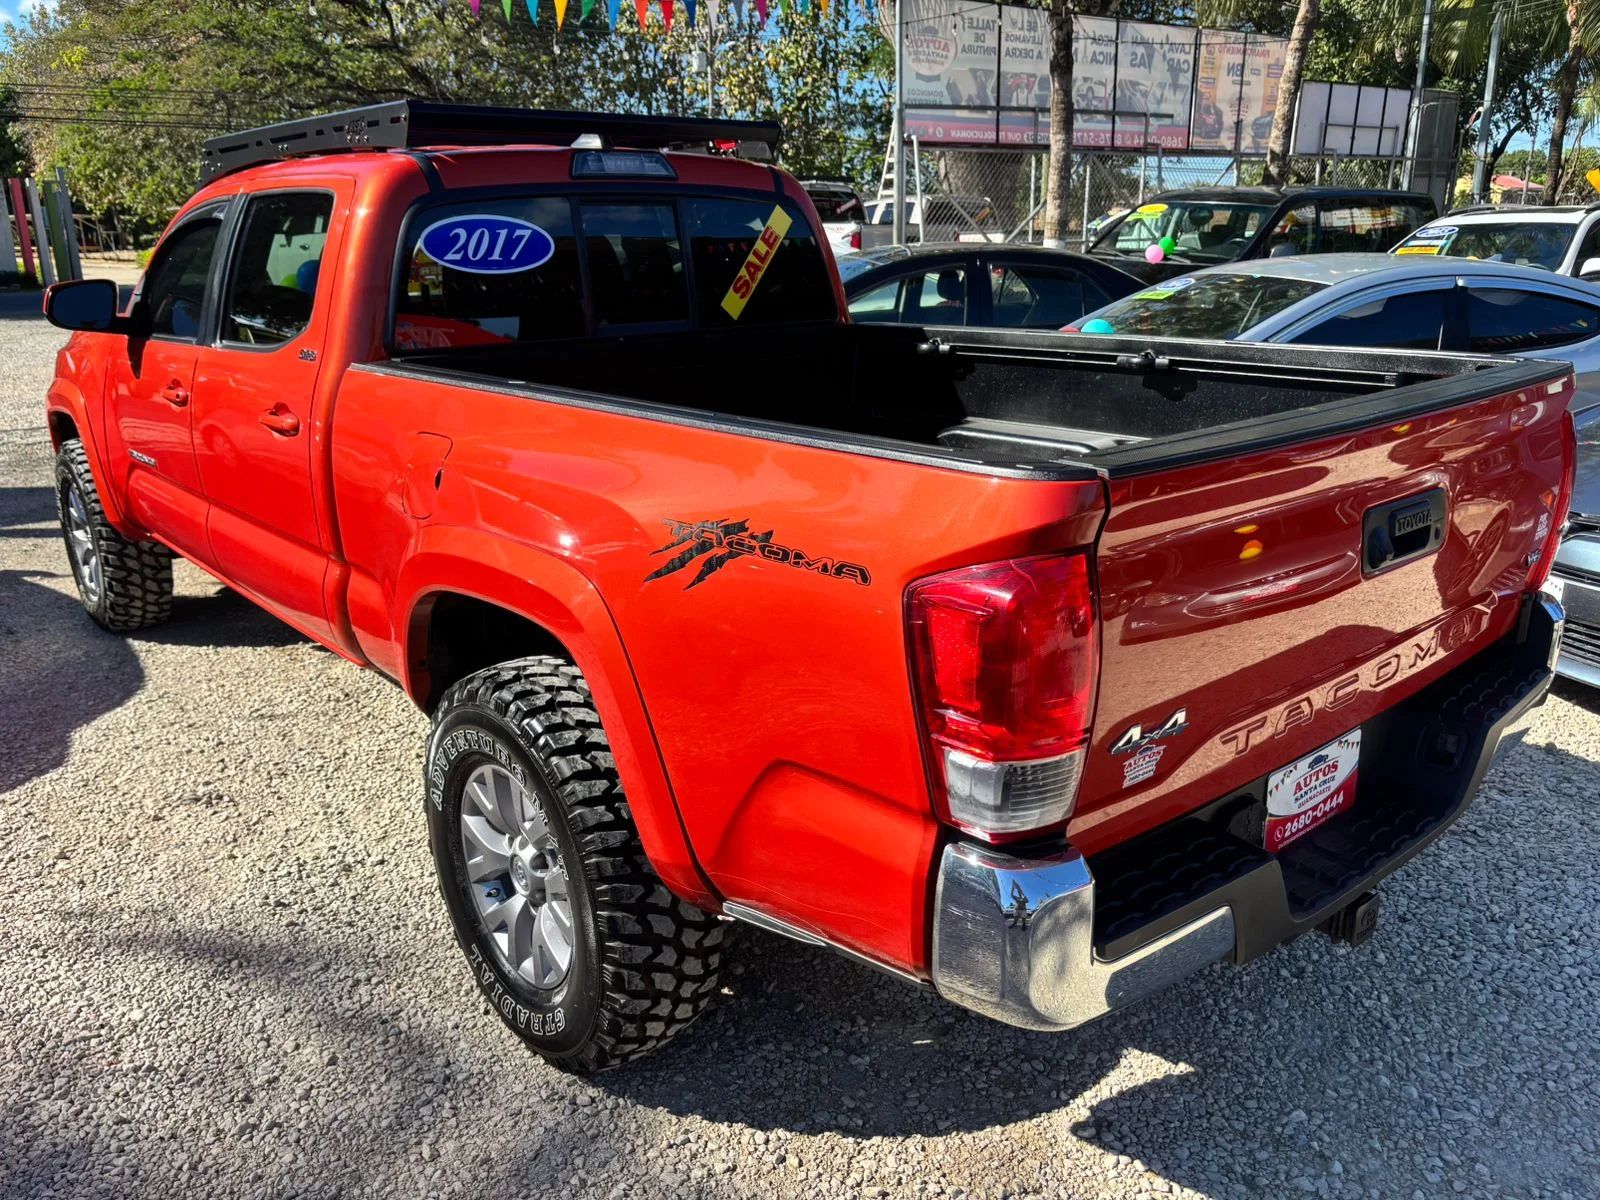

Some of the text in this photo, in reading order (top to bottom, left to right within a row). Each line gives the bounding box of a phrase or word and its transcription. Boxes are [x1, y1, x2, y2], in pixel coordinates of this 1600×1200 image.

[443, 227, 533, 261] 2017
[732, 225, 779, 299] SALE
[1396, 509, 1433, 532] TOYOTA
[661, 517, 872, 586] TACOMA
[1219, 613, 1472, 757] TACOMA
[1125, 750, 1162, 770] AUTOS
[1293, 760, 1340, 796] AUTOS
[1294, 774, 1336, 803] SANTA CRUZ
[1297, 785, 1332, 810] GUANACASTE
[1284, 790, 1344, 838] 2680-0444
[470, 943, 543, 1036] RADIAL
